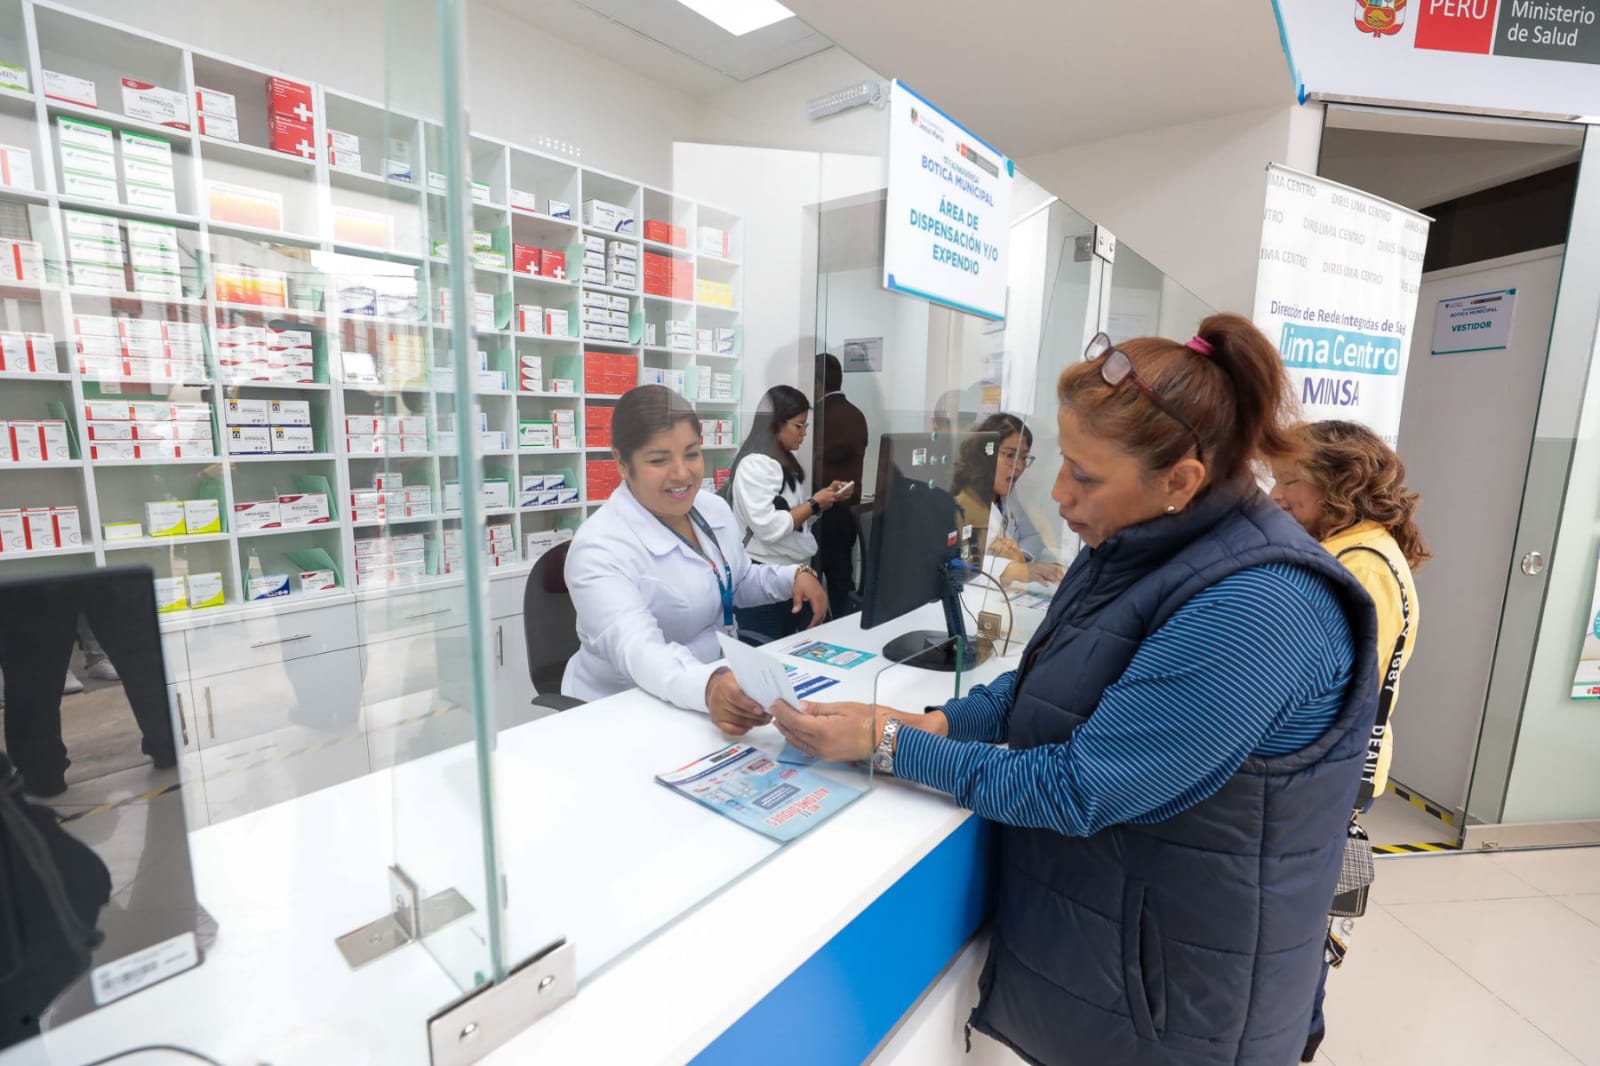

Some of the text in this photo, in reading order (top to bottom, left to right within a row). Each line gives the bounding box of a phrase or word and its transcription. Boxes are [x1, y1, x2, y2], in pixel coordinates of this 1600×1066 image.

[1510, 0, 1596, 25] Ministerio
[1507, 23, 1579, 47] de Salud
[921, 155, 953, 184] BOTICA
[955, 174, 994, 207] MUNICIPAL
[1286, 178, 1316, 198] CENTRO
[939, 194, 979, 231] ÁREA DE
[1368, 204, 1392, 223] CENTRO
[910, 207, 999, 262] DISPENSACIÓN Y/O
[932, 243, 980, 276] EXPENDIO
[1322, 261, 1343, 275] DIRIS
[1303, 306, 1316, 321] de
[1381, 318, 1394, 333] de
[1451, 320, 1493, 332] VESTIDOR
[1280, 327, 1399, 371] Lima Centro
[1302, 375, 1360, 407] MINSA
